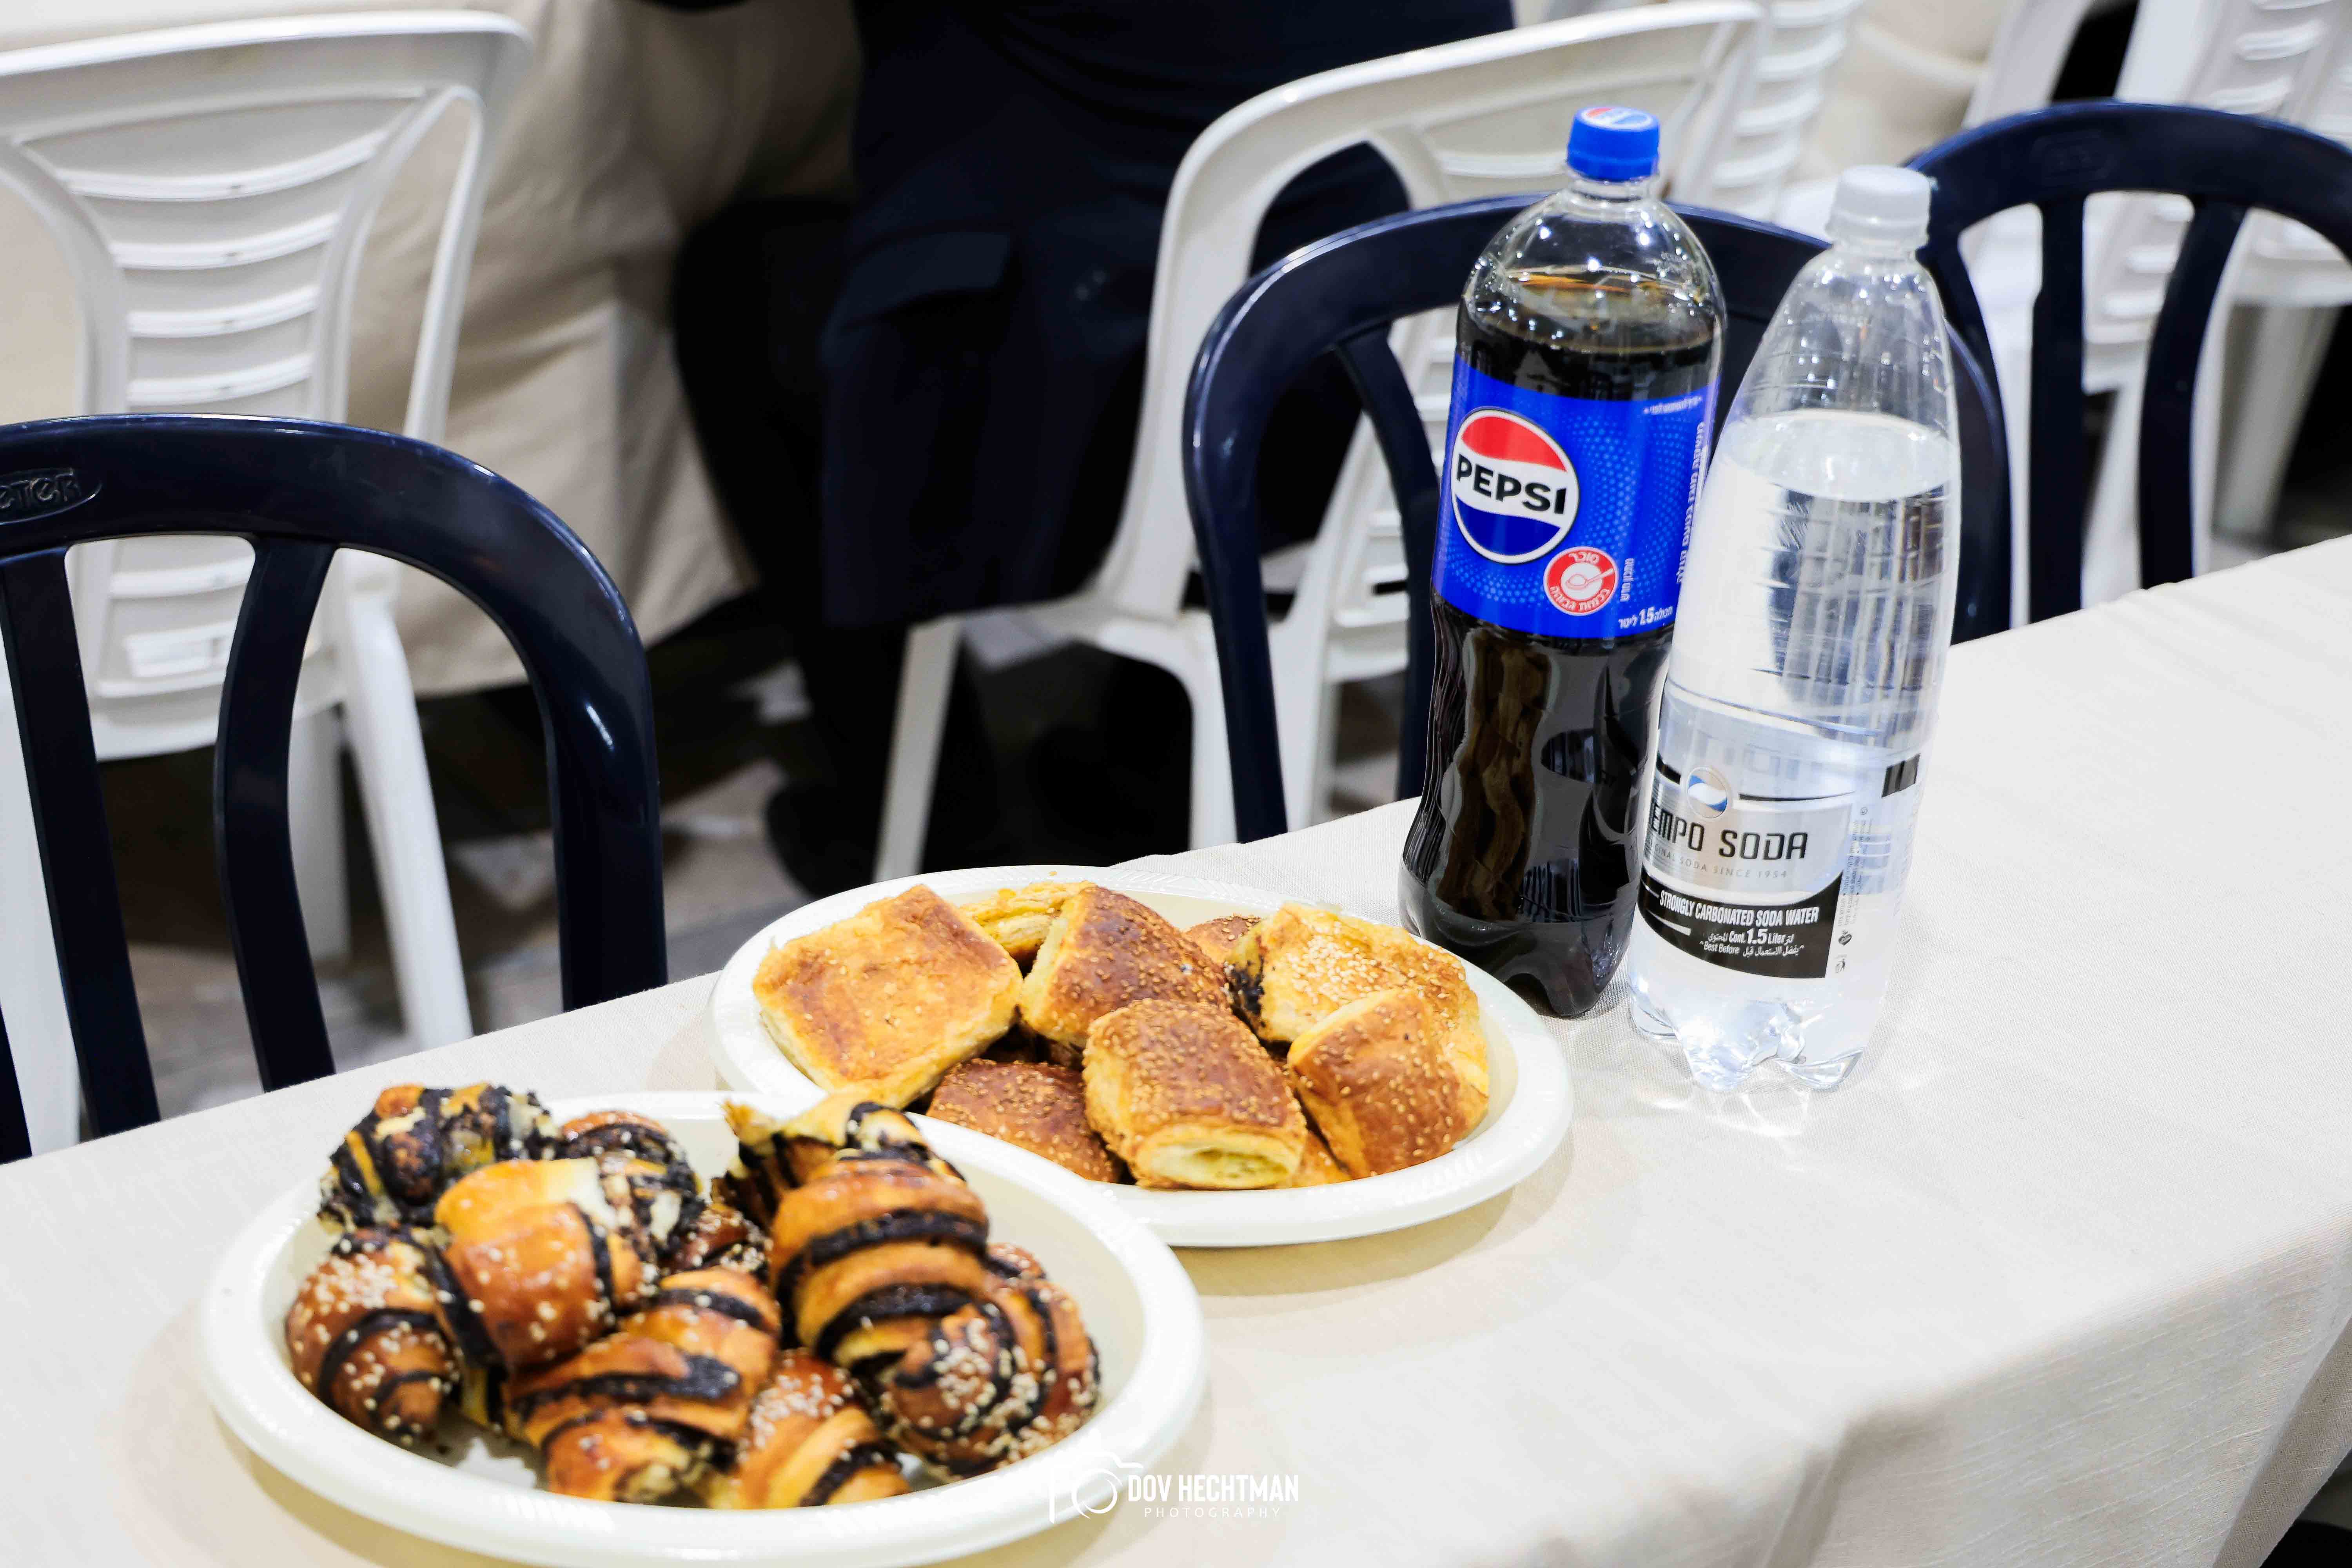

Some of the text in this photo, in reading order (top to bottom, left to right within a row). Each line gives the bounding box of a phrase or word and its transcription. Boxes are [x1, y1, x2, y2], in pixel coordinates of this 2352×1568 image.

[1457, 454, 1566, 515] PEPSI
[1568, 552, 1600, 564] סוכר
[1550, 586, 1610, 611] בכמות גבוהה
[1618, 614, 1638, 629] ליטר
[1654, 606, 1673, 621] תכולה
[1719, 829, 1808, 860] SODA
[1681, 857, 1707, 872] SODA
[1712, 865, 1750, 878] SINCE
[1660, 890, 1820, 927] STRONGLY CARBONATED SODA WATER
[1729, 928, 1786, 945] Cont. 1.5 Liter
[1704, 941, 1741, 955] Best Before
